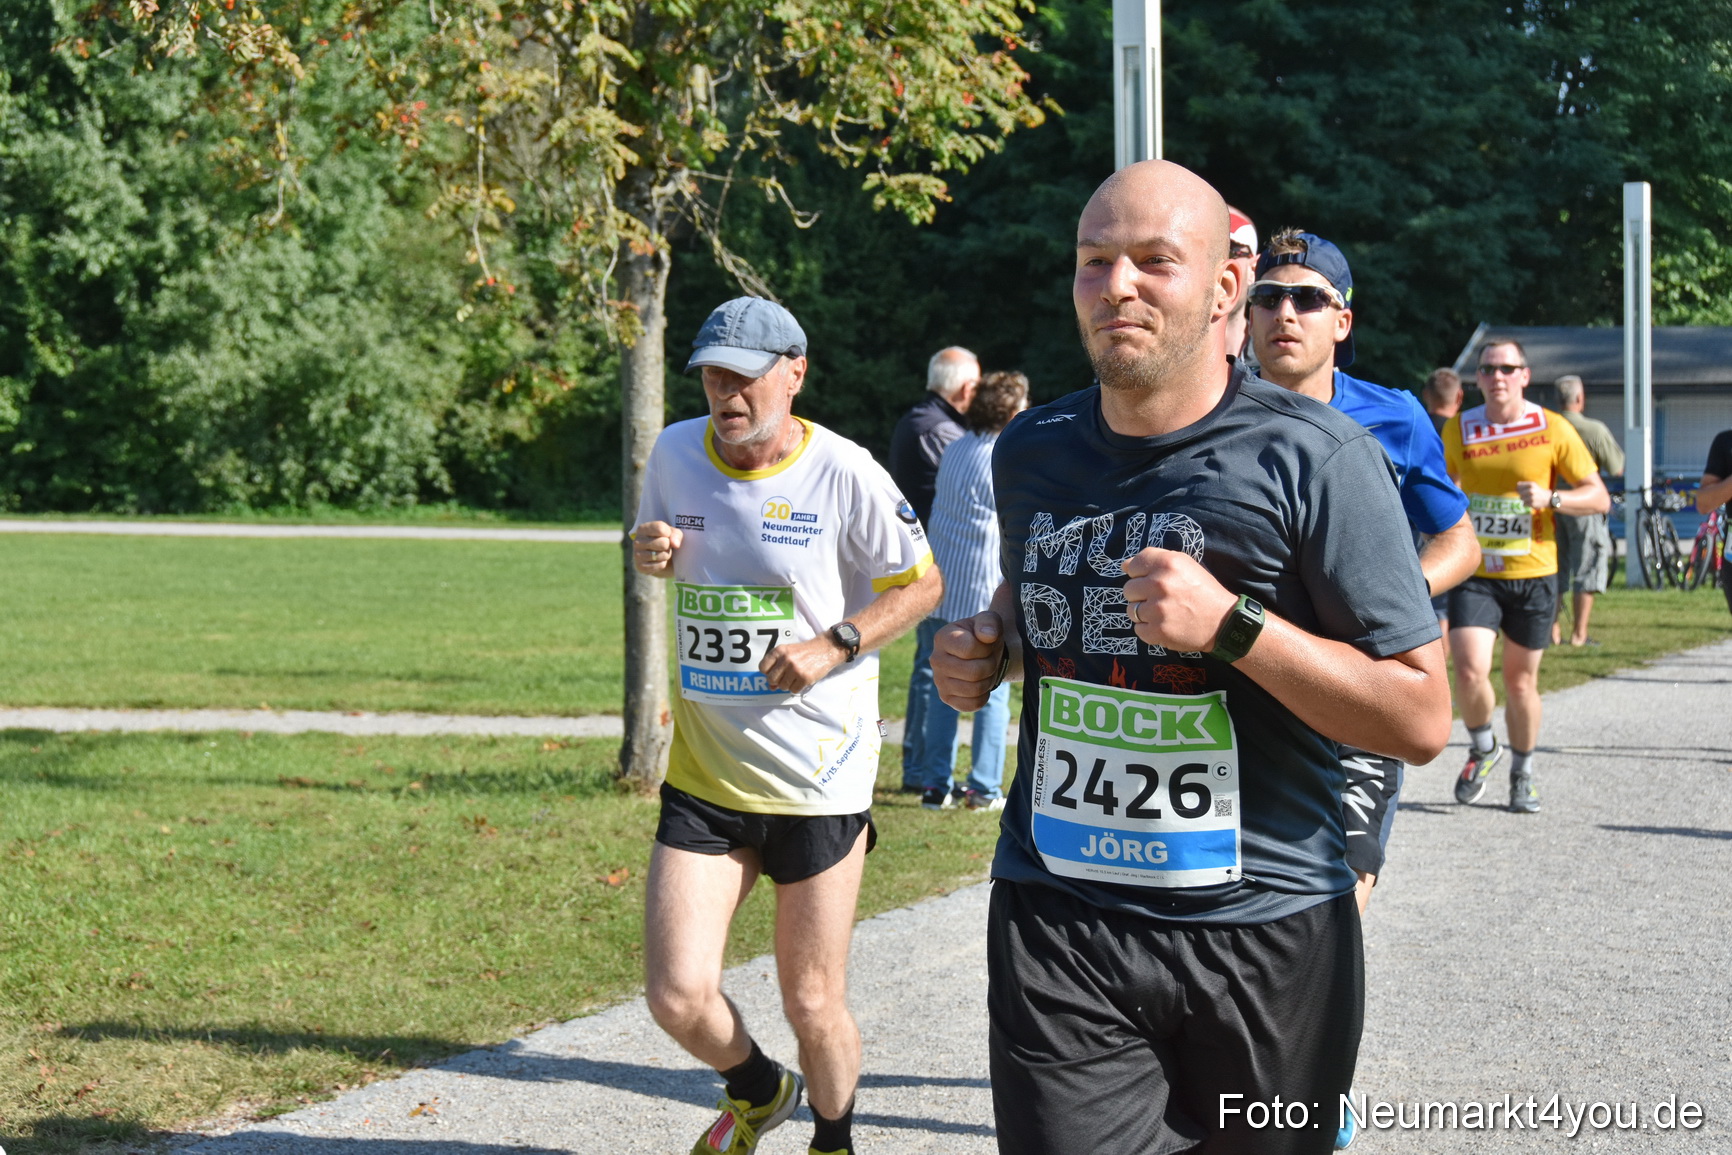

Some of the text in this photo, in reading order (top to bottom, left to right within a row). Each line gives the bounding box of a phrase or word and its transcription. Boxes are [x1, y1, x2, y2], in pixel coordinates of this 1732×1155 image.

[1462, 435, 1549, 460] MAX BÖGL
[764, 502, 816, 522] 20 JAHRE
[1471, 495, 1526, 513] BOCK
[675, 515, 705, 528] BOCK
[762, 521, 824, 535] Neumarkter
[1474, 516, 1522, 534] 1234
[761, 533, 810, 548] Stadtlauf
[682, 587, 785, 617] BOCK
[1021, 582, 1203, 659] DE
[687, 625, 779, 664] 2337
[690, 672, 787, 691] REINHAR
[1049, 685, 1217, 747] BOCK
[1052, 750, 1212, 819] 2426
[1080, 831, 1168, 864] JÖRG
